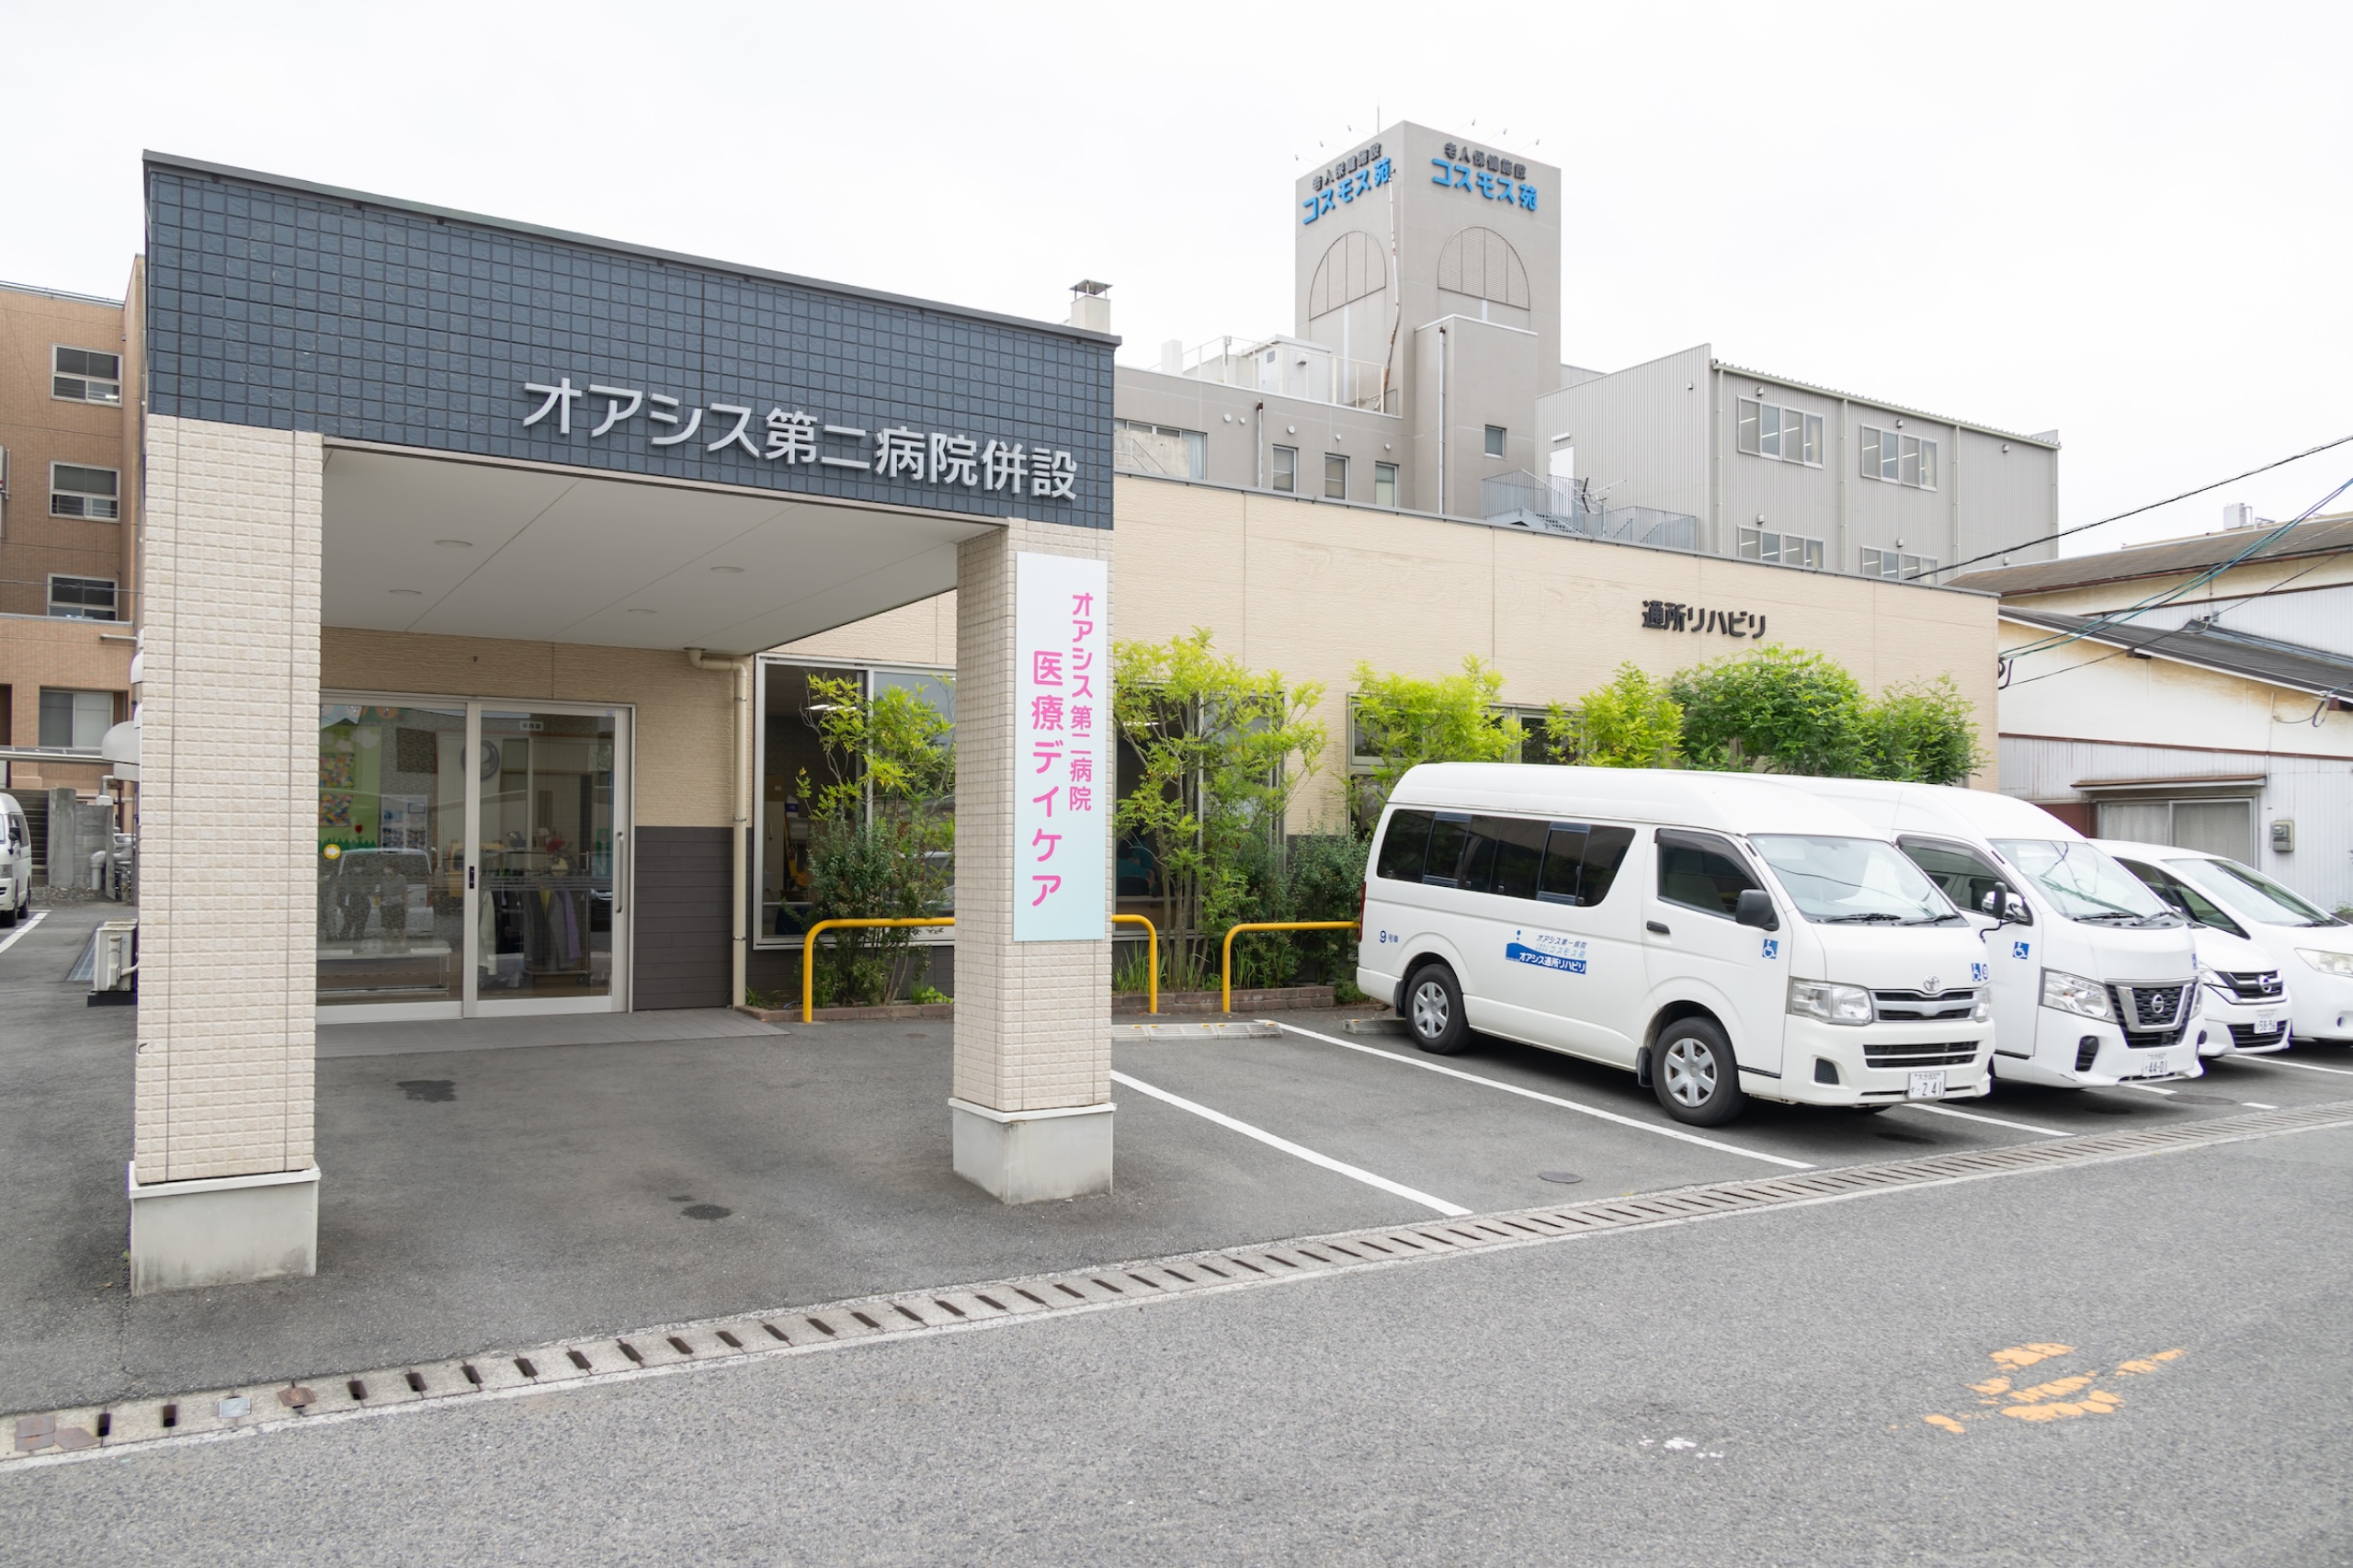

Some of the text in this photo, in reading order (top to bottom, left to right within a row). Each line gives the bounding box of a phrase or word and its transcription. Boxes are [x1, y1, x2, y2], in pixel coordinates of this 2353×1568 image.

[1313, 142, 1381, 191] 老人保健施設
[1431, 157, 1538, 211] コスモス苑
[1444, 142, 1527, 180] 老人保健施設
[1302, 156, 1391, 225] コスモス苑
[522, 377, 1078, 502] オアシス第二病院併設
[1642, 599, 1766, 639] 通所リハビリ
[1069, 592, 1094, 812] オアシス第二病院
[1030, 650, 1064, 907] 医療デイケア
[1519, 951, 1586, 972] オアシス通所リハビリ
